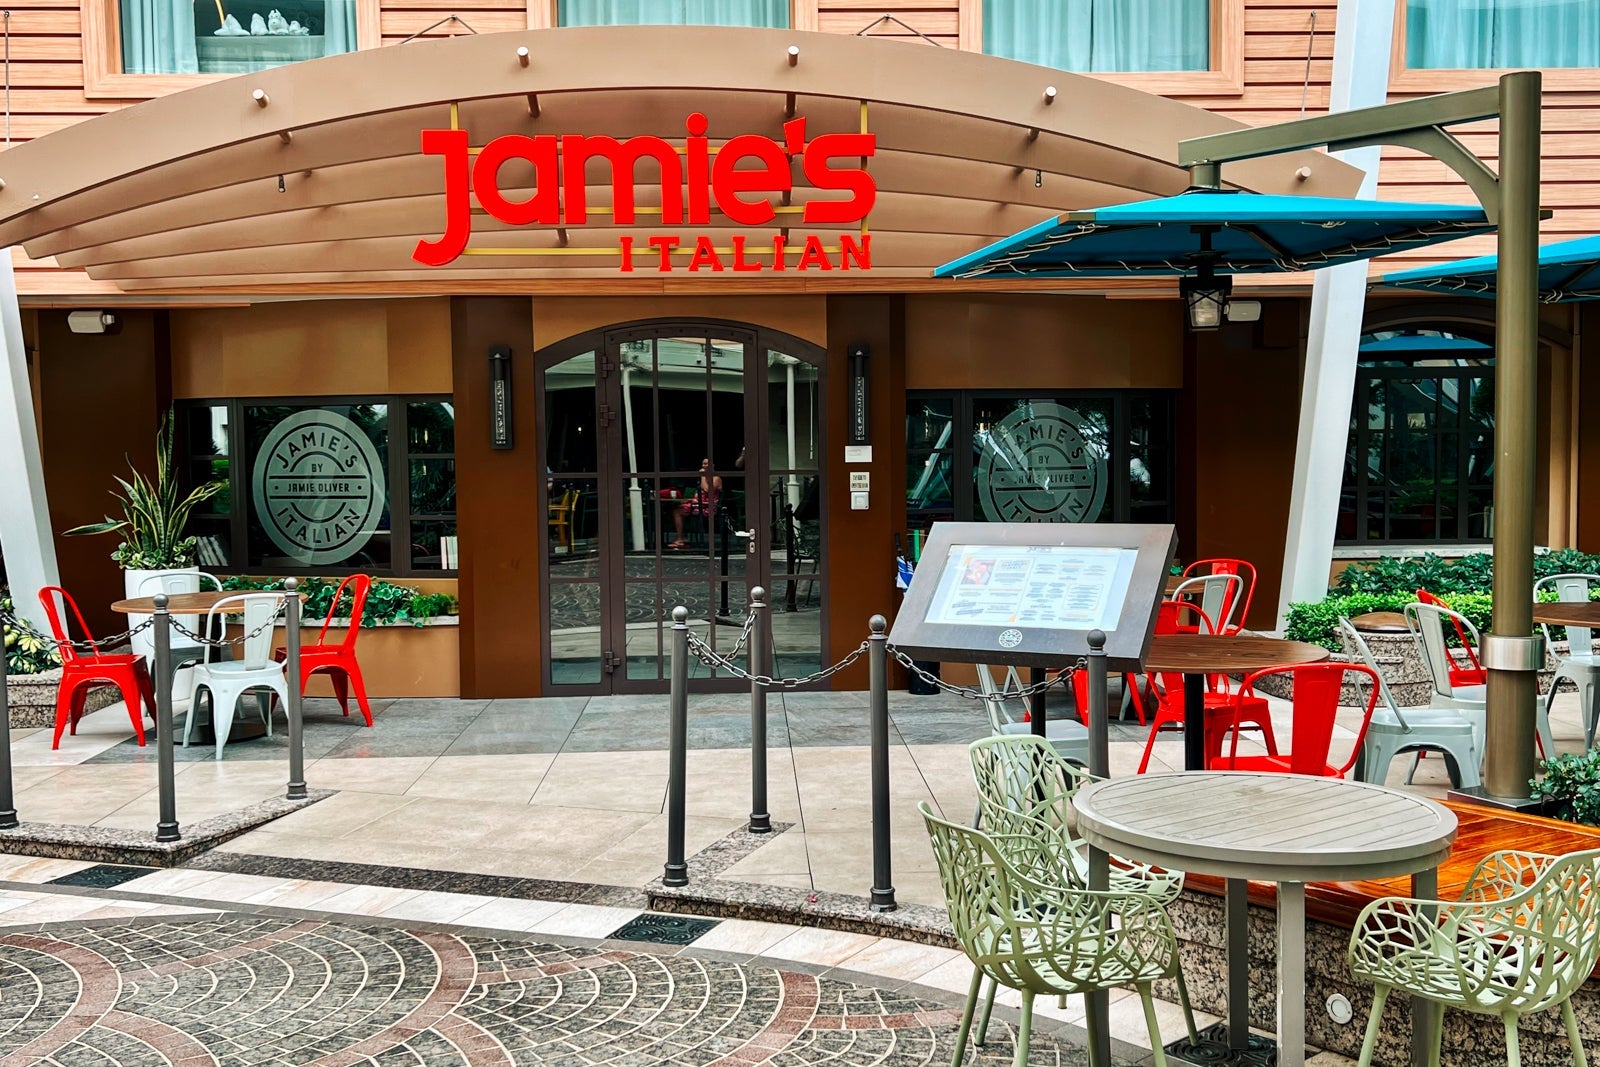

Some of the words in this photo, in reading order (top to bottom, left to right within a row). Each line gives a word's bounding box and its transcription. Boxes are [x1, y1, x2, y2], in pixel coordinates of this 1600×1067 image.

[411, 112, 877, 267] Jamie's
[619, 234, 872, 272] ITALIAN
[276, 431, 358, 469] JAMIE'S
[1038, 455, 1050, 464] BY
[311, 463, 324, 473] BY
[1044, 473, 1075, 483] LIVER
[287, 483, 315, 493] JAMIE
[318, 483, 350, 493] OLIVER
[277, 507, 361, 544] ITALIAN
